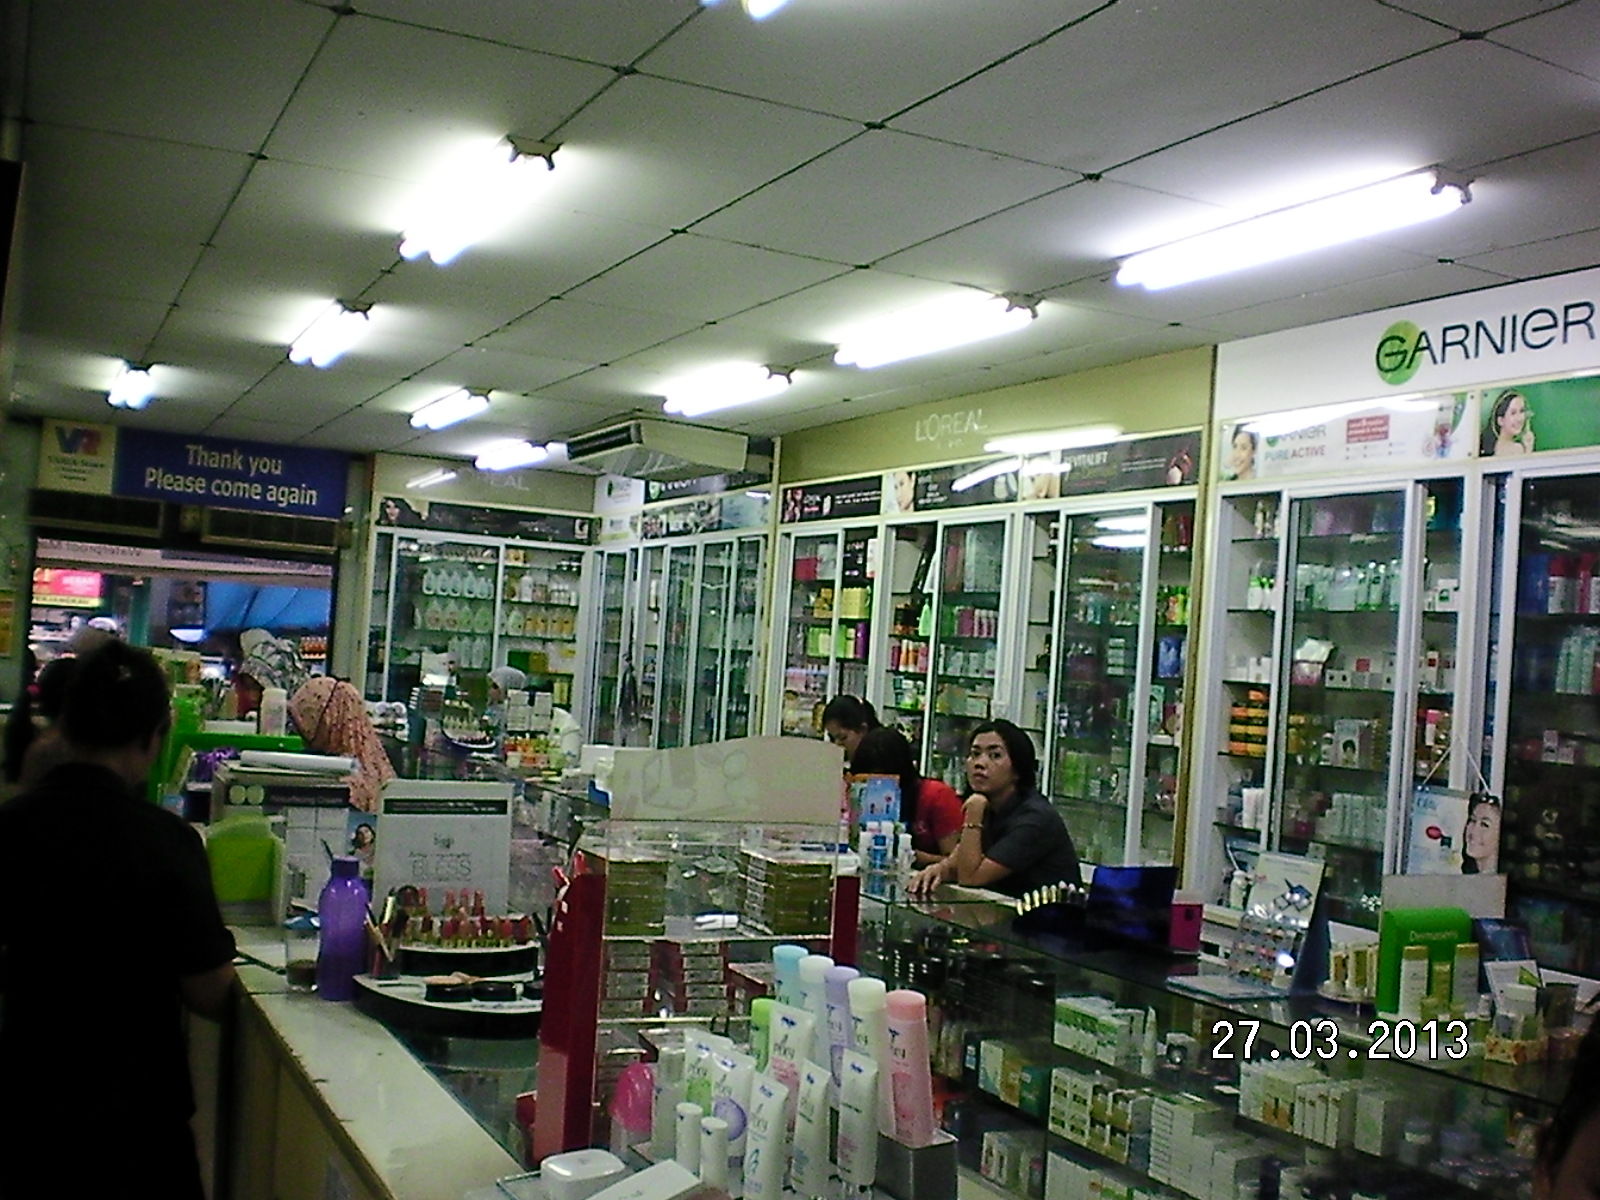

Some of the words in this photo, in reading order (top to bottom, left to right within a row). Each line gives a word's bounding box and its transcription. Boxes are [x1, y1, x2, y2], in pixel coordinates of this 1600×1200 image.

[186, 444, 243, 470] Thank
[248, 455, 282, 477] you
[1291, 444, 1326, 459] ACTIVE
[144, 466, 206, 496] Please
[210, 478, 262, 500] come
[266, 483, 318, 508] again
